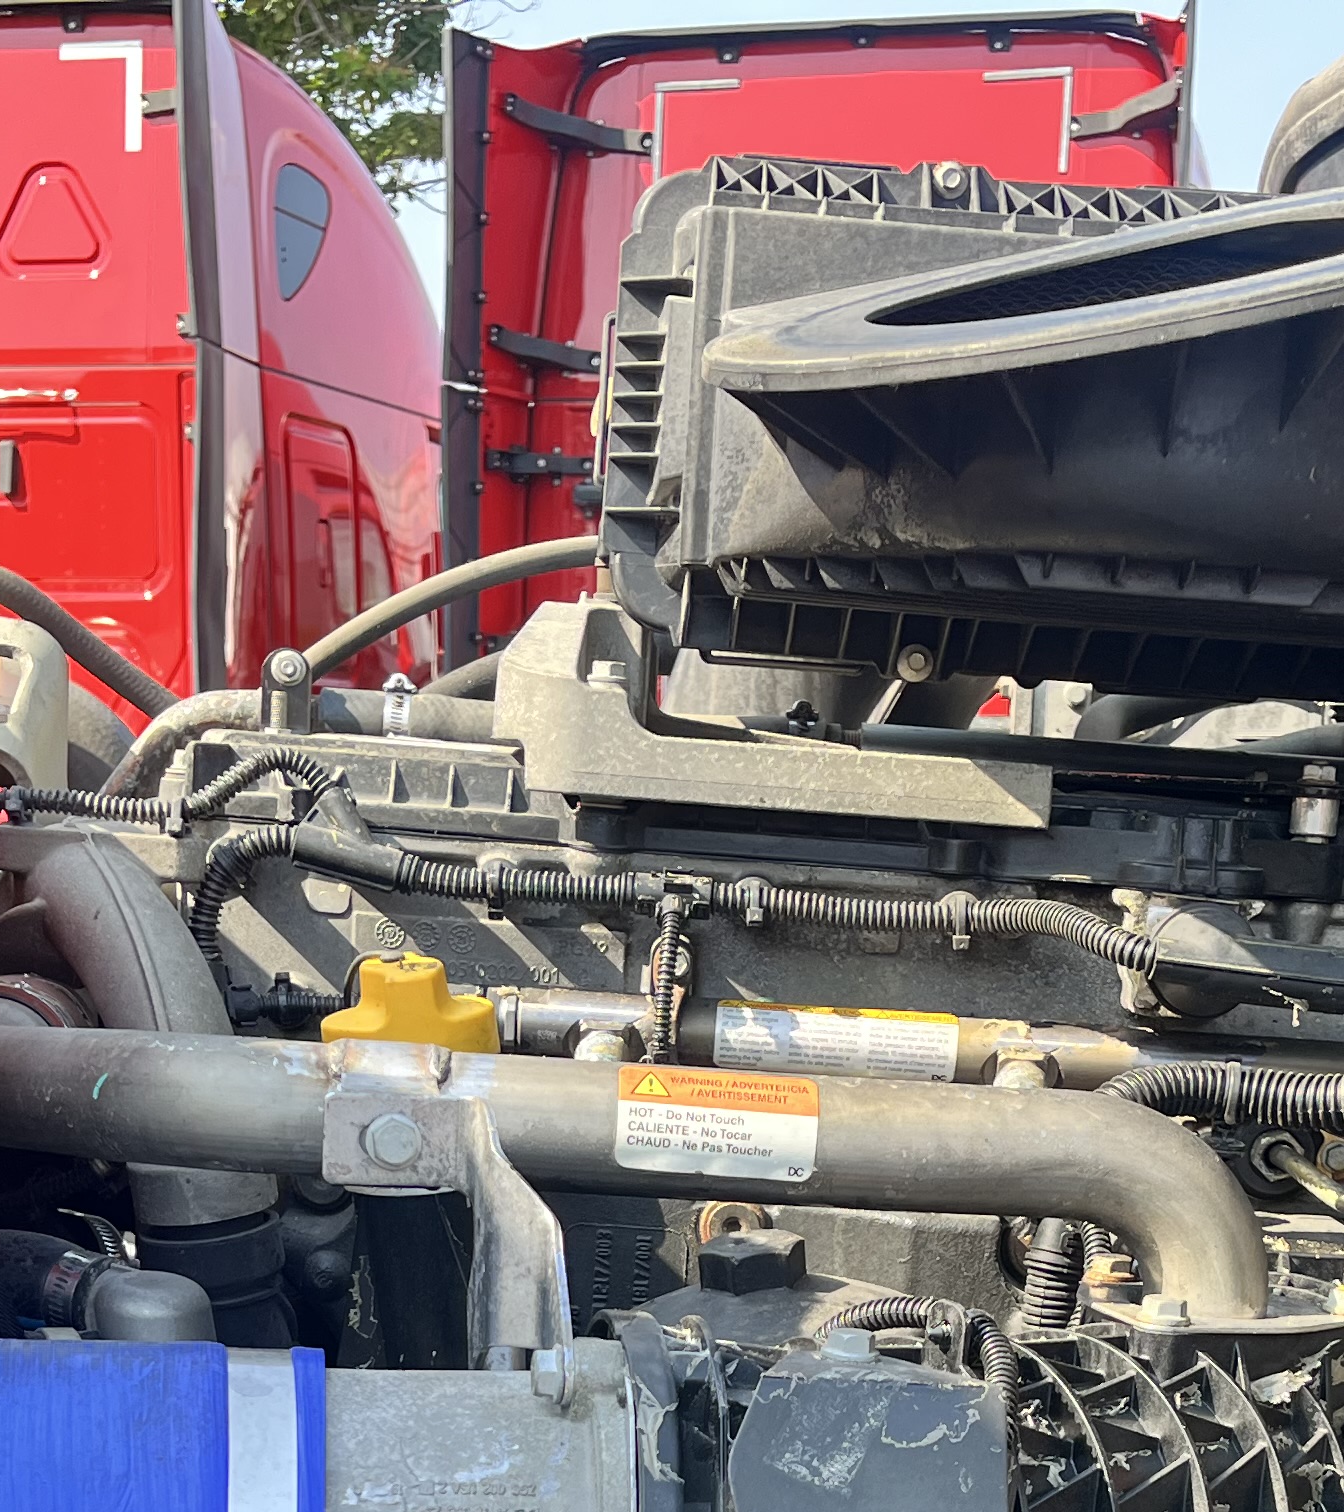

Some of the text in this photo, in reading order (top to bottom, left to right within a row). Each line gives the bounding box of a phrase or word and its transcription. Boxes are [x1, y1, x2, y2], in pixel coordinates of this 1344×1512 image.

[670, 1076, 810, 1095] WARNING ADVERTENCIA
[697, 1089, 789, 1105] AVERTISSEMENT
[629, 1106, 745, 1126] HOT Do Not Touch
[627, 1120, 753, 1141] CALIENTE No Tocar
[626, 1135, 774, 1158] CHAUD Ne Pas Toucher
[787, 1166, 805, 1178] DC
